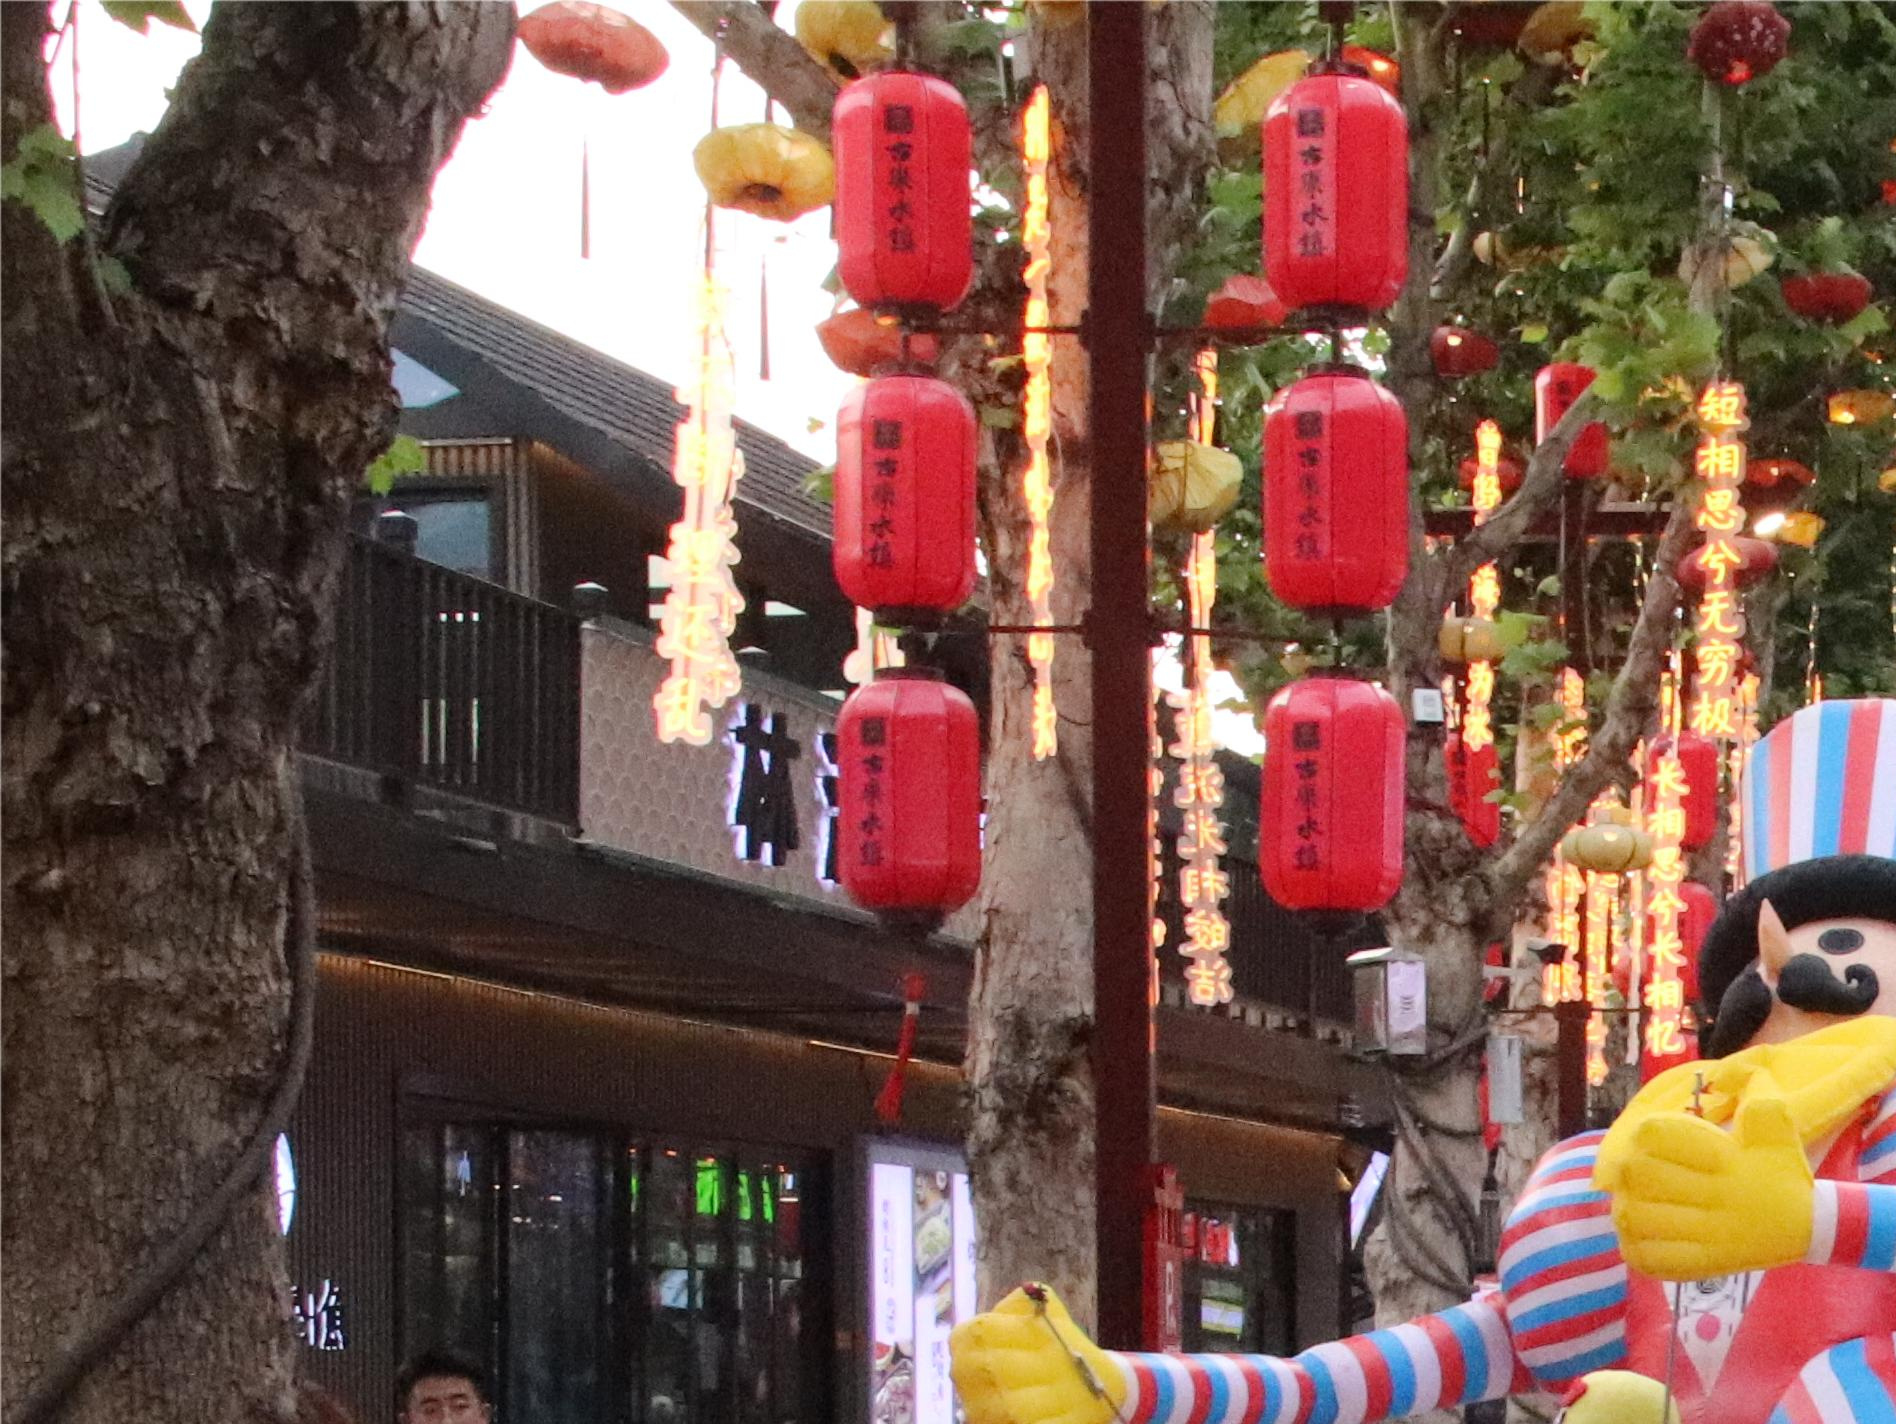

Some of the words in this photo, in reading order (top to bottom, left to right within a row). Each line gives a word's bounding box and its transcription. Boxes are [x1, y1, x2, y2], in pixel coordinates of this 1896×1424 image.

[1693, 381, 1747, 738] 短相思兮无穷极
[1645, 757, 1690, 1056] 长相思兮长相忆
